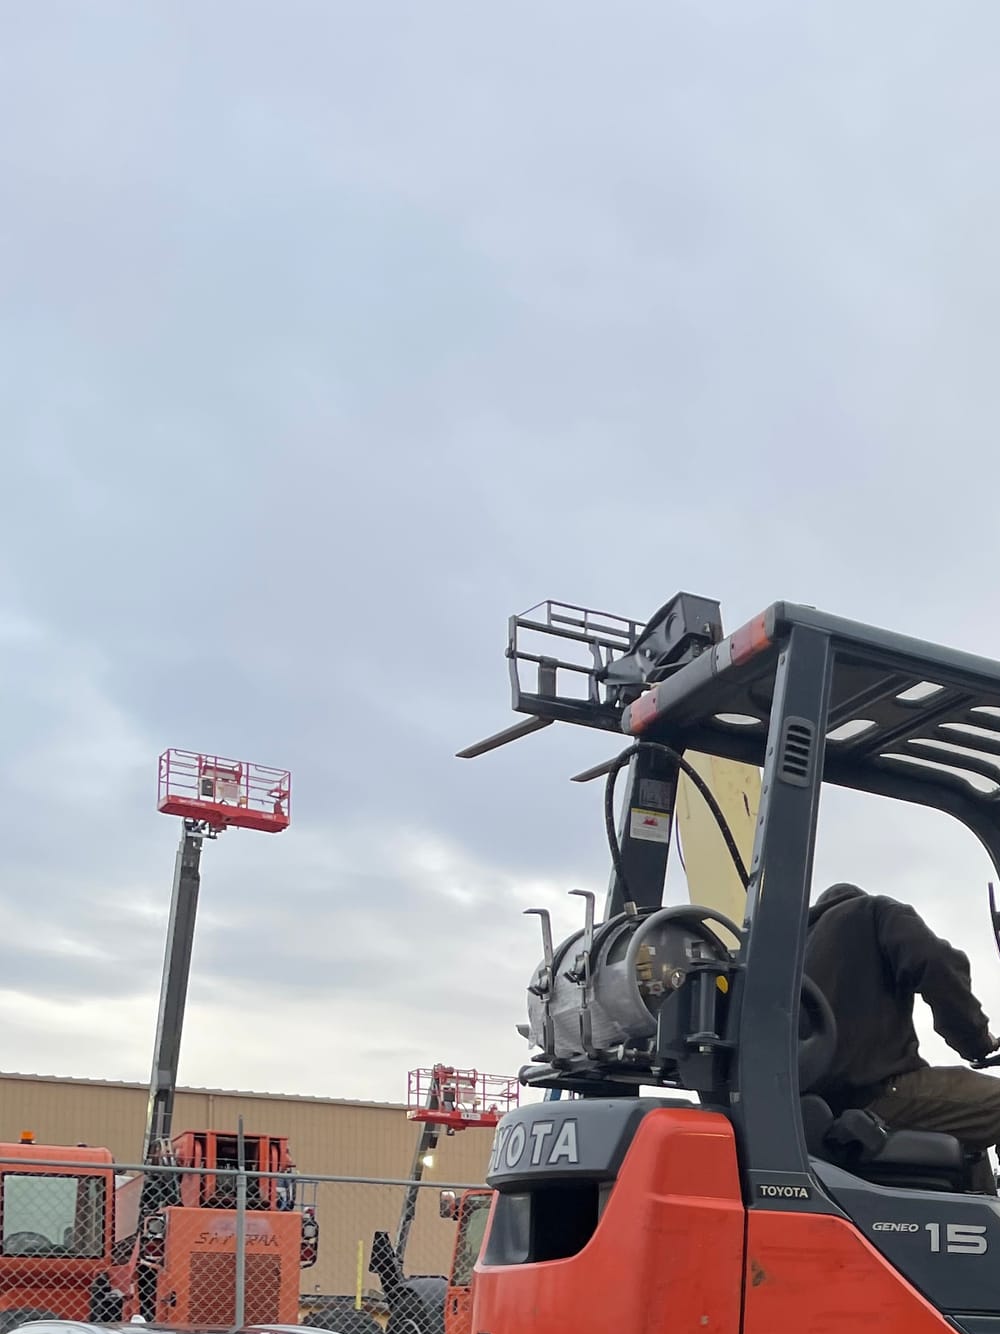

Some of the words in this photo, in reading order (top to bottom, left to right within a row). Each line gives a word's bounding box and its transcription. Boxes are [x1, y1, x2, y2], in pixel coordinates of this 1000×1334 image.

[489, 1117, 579, 1171] YOTA
[760, 1185, 808, 1198] TOYOTA
[194, 1232, 279, 1247] SKYRAK
[872, 1222, 919, 1233] GENEO
[925, 1223, 988, 1255] 15
